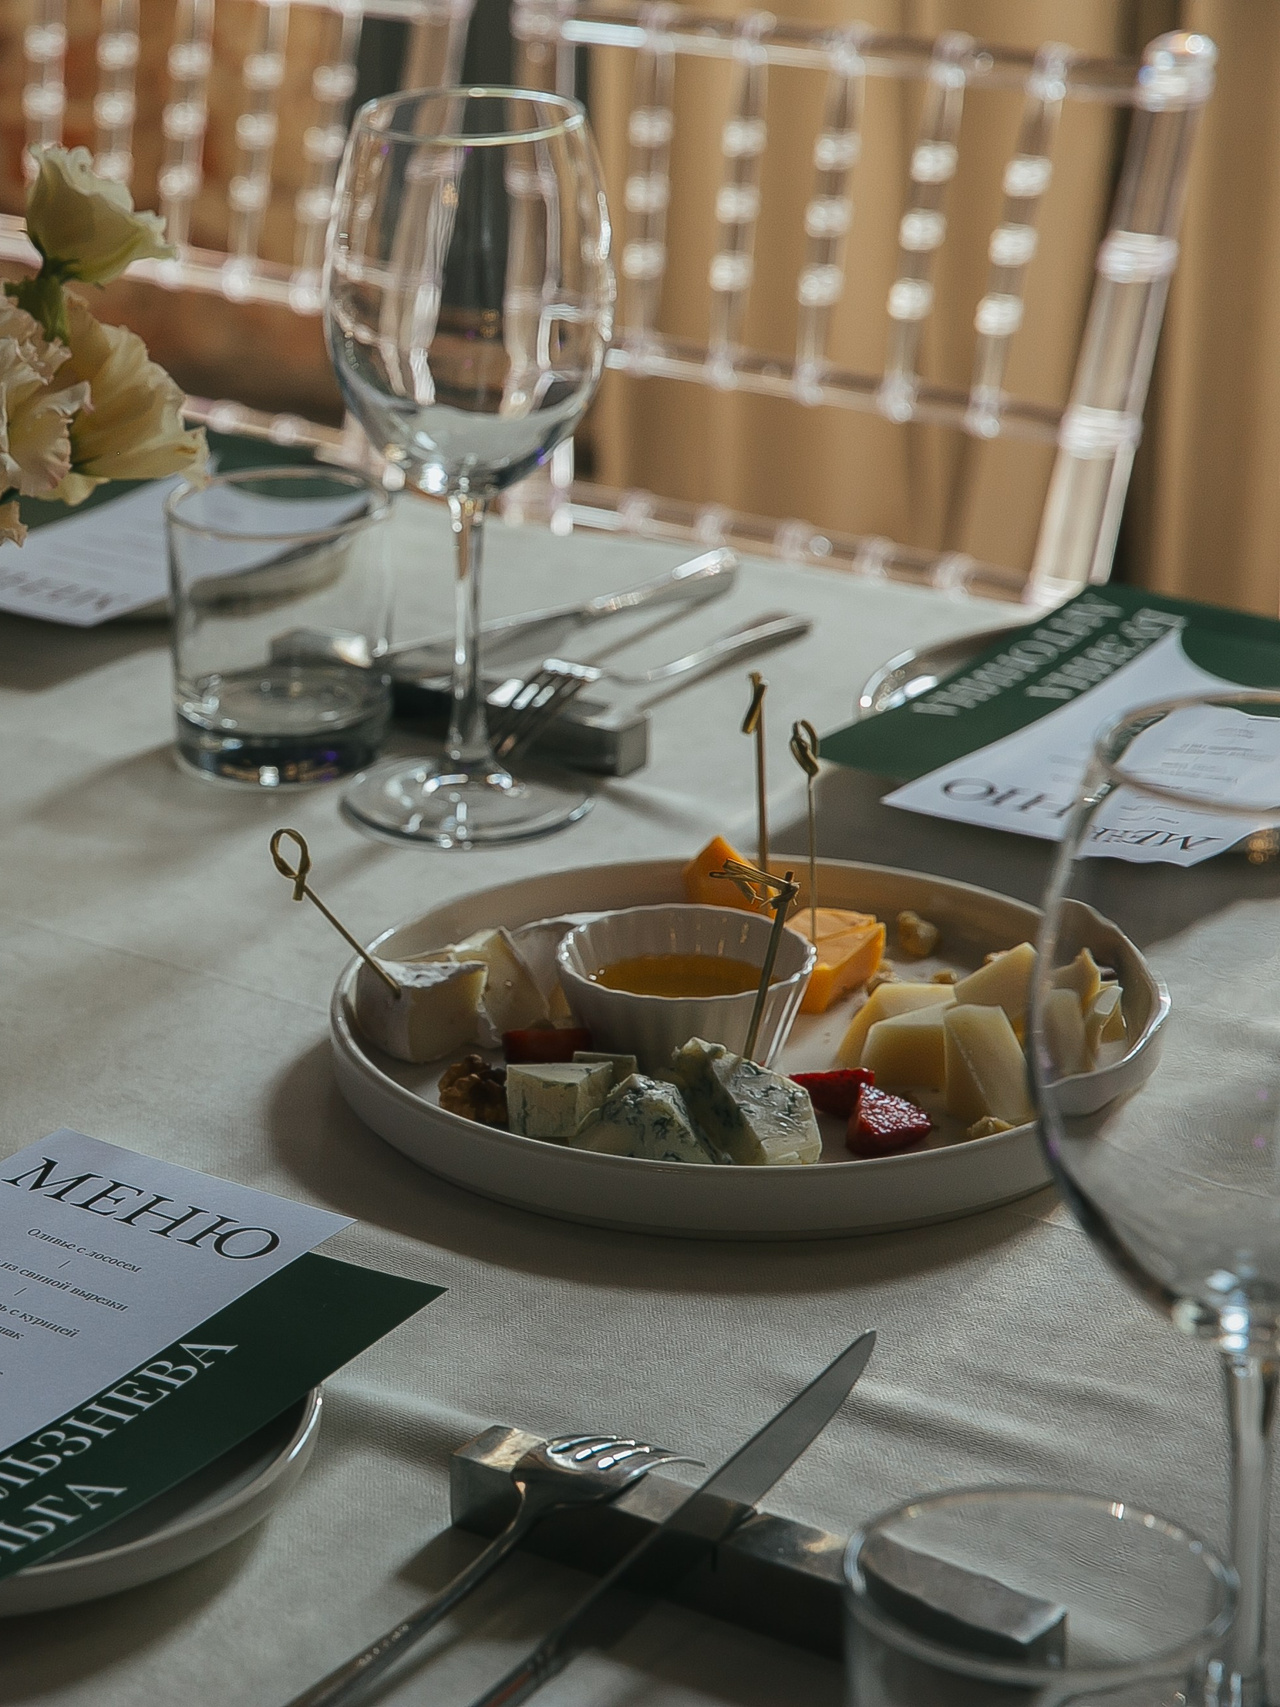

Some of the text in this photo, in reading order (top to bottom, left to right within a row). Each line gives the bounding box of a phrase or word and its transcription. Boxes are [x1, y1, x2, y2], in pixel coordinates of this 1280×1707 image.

[1, 1156, 280, 1260] МЕНЮ
[27, 1227, 77, 1251] Оливье
[84, 1250, 142, 1274] лососем
[0, 1261, 19, 1272] из
[19, 1268, 72, 1291] свиной
[70, 1287, 129, 1313] вырезки
[19, 1312, 80, 1338] курицей
